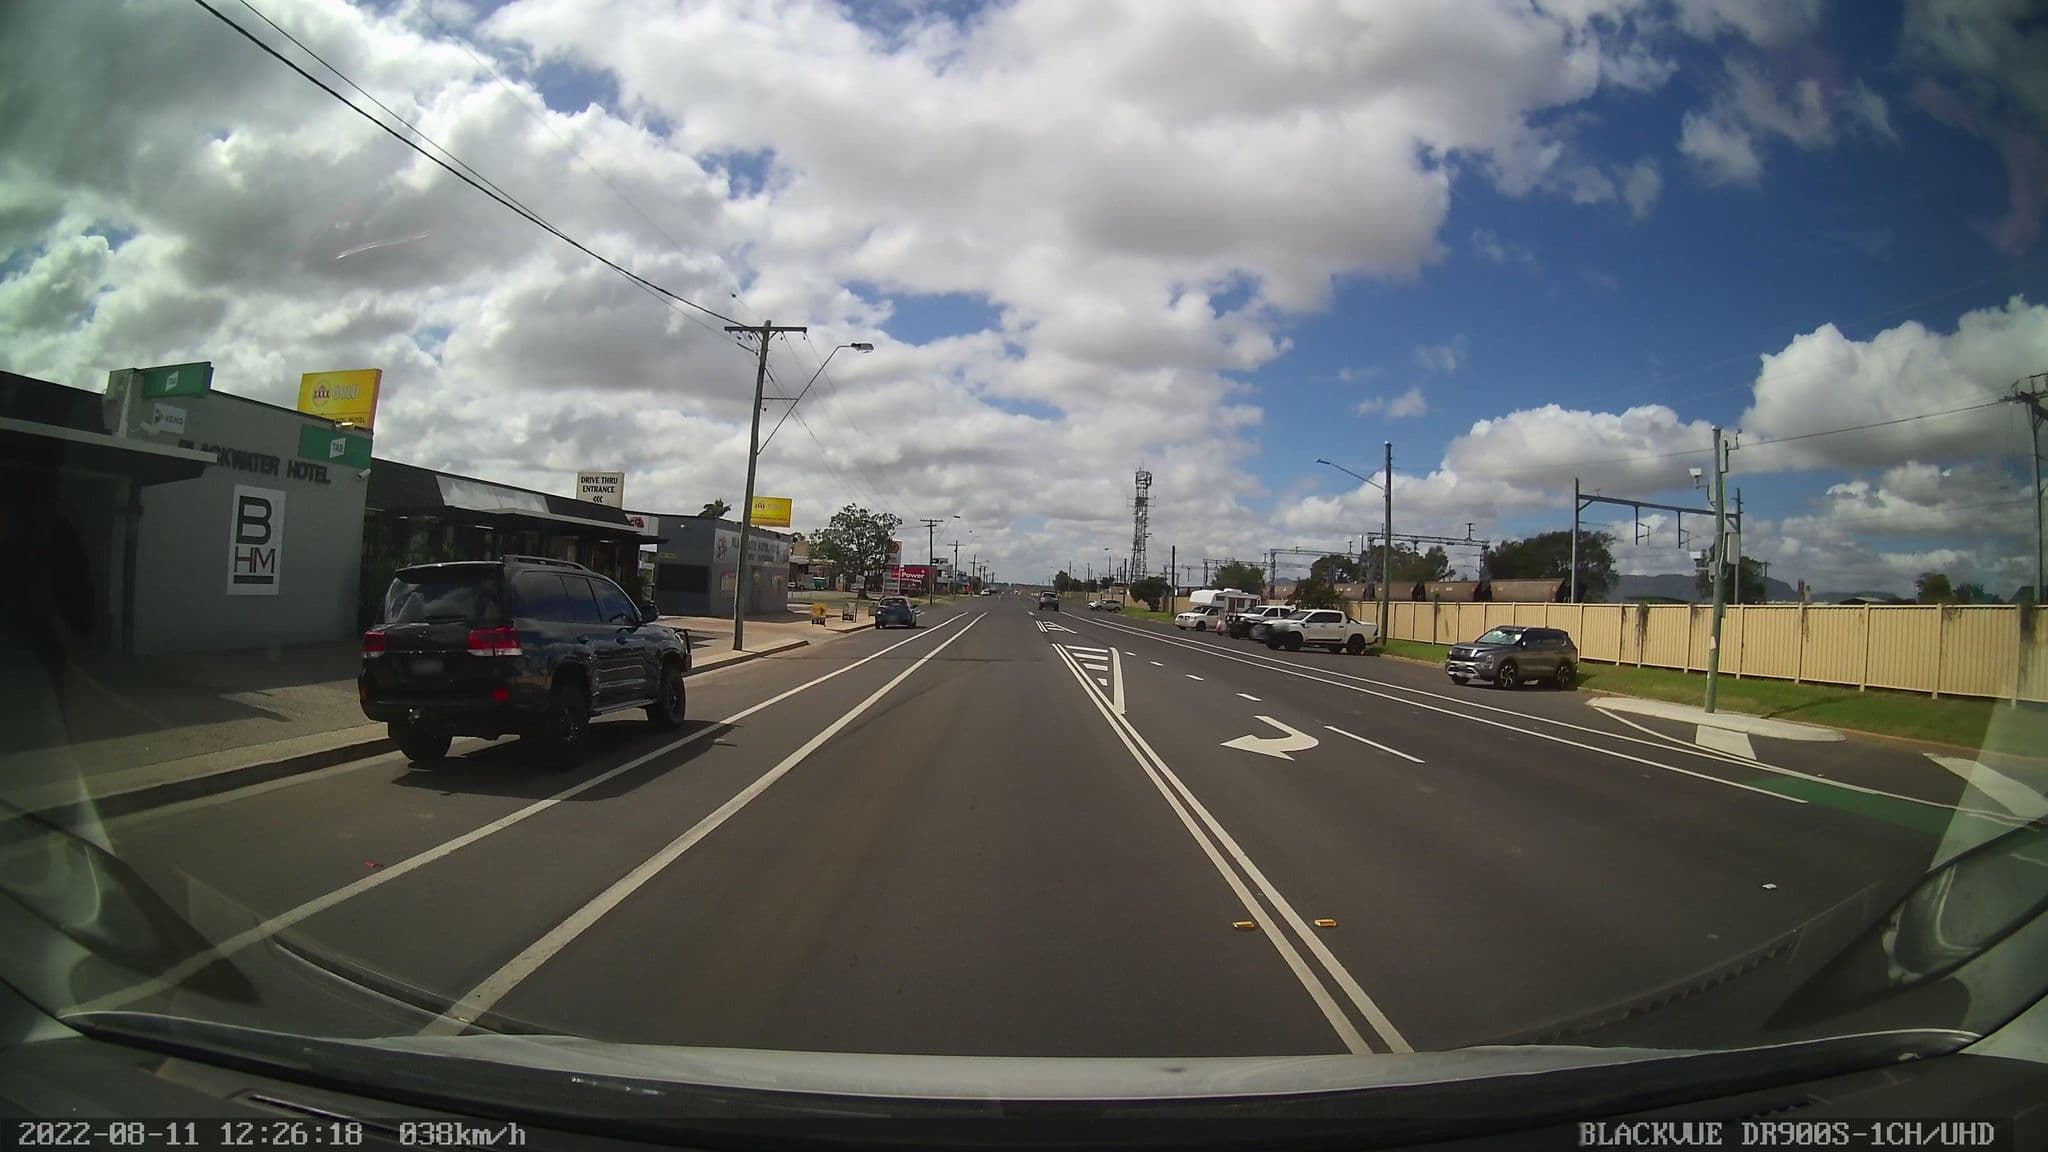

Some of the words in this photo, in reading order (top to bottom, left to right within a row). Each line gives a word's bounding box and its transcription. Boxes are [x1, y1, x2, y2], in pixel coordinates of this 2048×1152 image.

[332, 442, 344, 454] TAB
[177, 439, 280, 476] CKWATER
[287, 458, 331, 486] HOTEL
[581, 476, 601, 484] DRIVE
[583, 485, 616, 493] ENTRANCE
[236, 495, 272, 545] B
[233, 545, 276, 574] HM
[901, 571, 925, 579] Power
